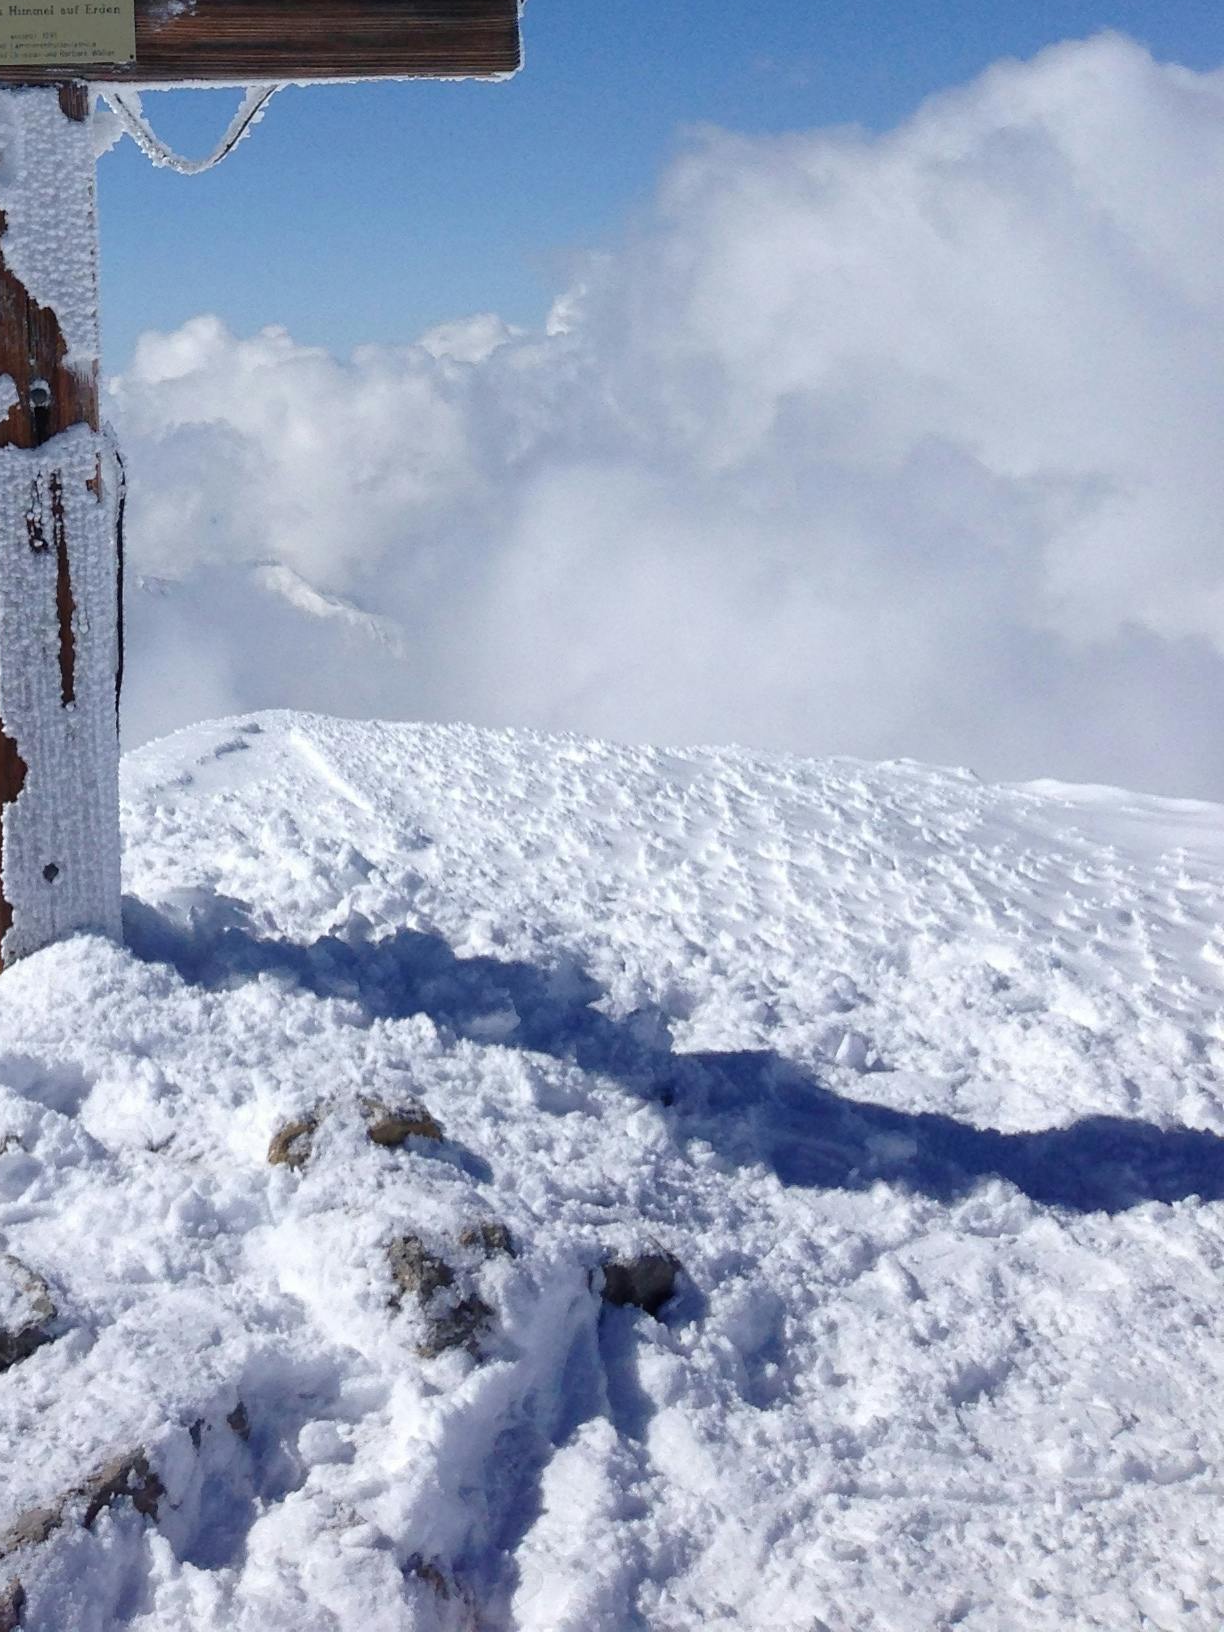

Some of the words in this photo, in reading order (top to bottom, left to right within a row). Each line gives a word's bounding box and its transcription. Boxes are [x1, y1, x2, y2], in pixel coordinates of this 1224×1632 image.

[9, 5, 54, 16] Himmel
[60, 5, 80, 15] auf
[86, 3, 121, 16] Erden
